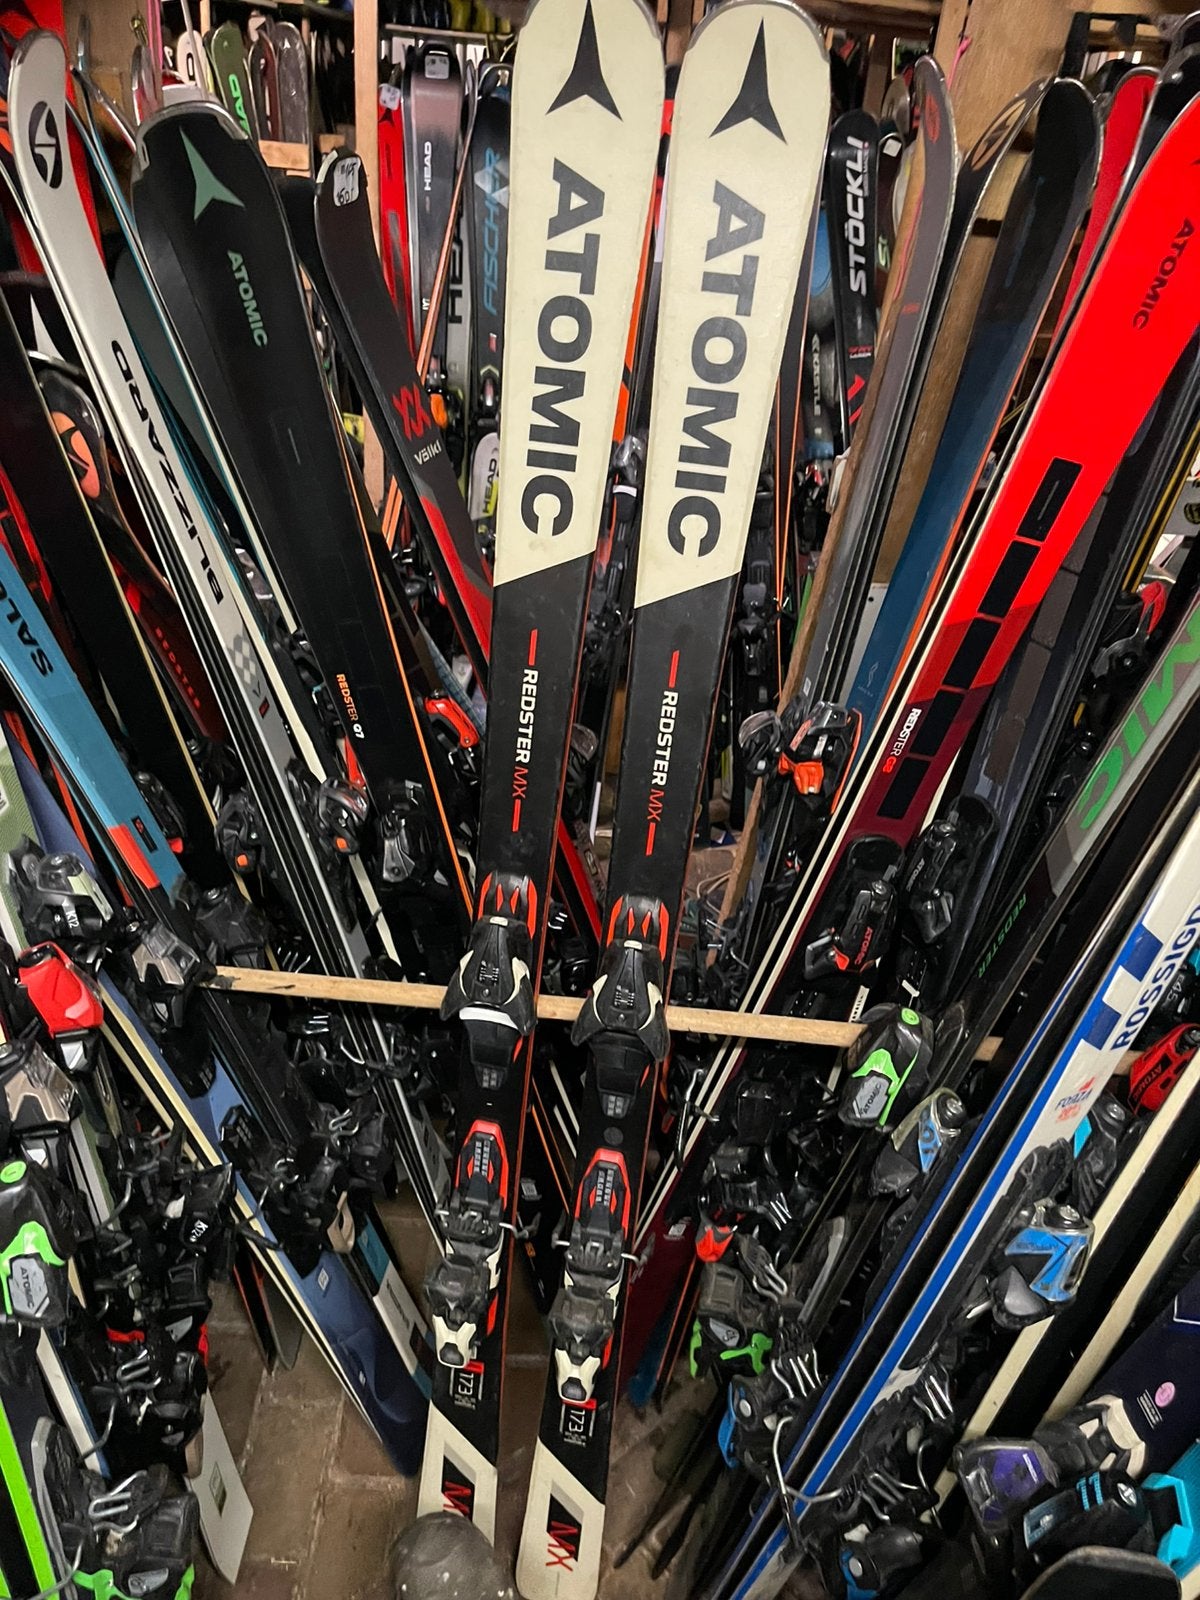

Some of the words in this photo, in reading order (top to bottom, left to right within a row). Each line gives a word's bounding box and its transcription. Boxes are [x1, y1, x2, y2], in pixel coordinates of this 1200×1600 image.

[229, 73, 251, 134] AD
[424, 140, 432, 191] HEAD
[484, 147, 499, 316] FISCHER
[227, 250, 268, 347] ATOMIC
[1133, 217, 1195, 330] ATOMIC
[521, 157, 605, 537] ATOMIC
[667, 180, 766, 557] ATOMIC
[111, 340, 224, 604] BLIZZARD
[483, 458, 497, 514] HEAD
[336, 673, 358, 721] REDSTER
[515, 668, 538, 763] REDSTER
[1078, 597, 1200, 829] MIC
[651, 691, 678, 786] REDSTER
[890, 707, 922, 756] REDSTER
[512, 766, 528, 799] MX
[647, 789, 664, 821] MX
[905, 858, 925, 892] ATOMIC
[855, 926, 873, 965] ATOMIC
[978, 893, 1026, 978] REDSTER
[863, 1084, 882, 1114] ATOMIC
[20, 1266, 35, 1309] ATOMIC
[458, 1373, 474, 1395] 173
[568, 1410, 585, 1432] 173
[443, 1480, 472, 1518] M
[546, 1521, 578, 1571] MX
